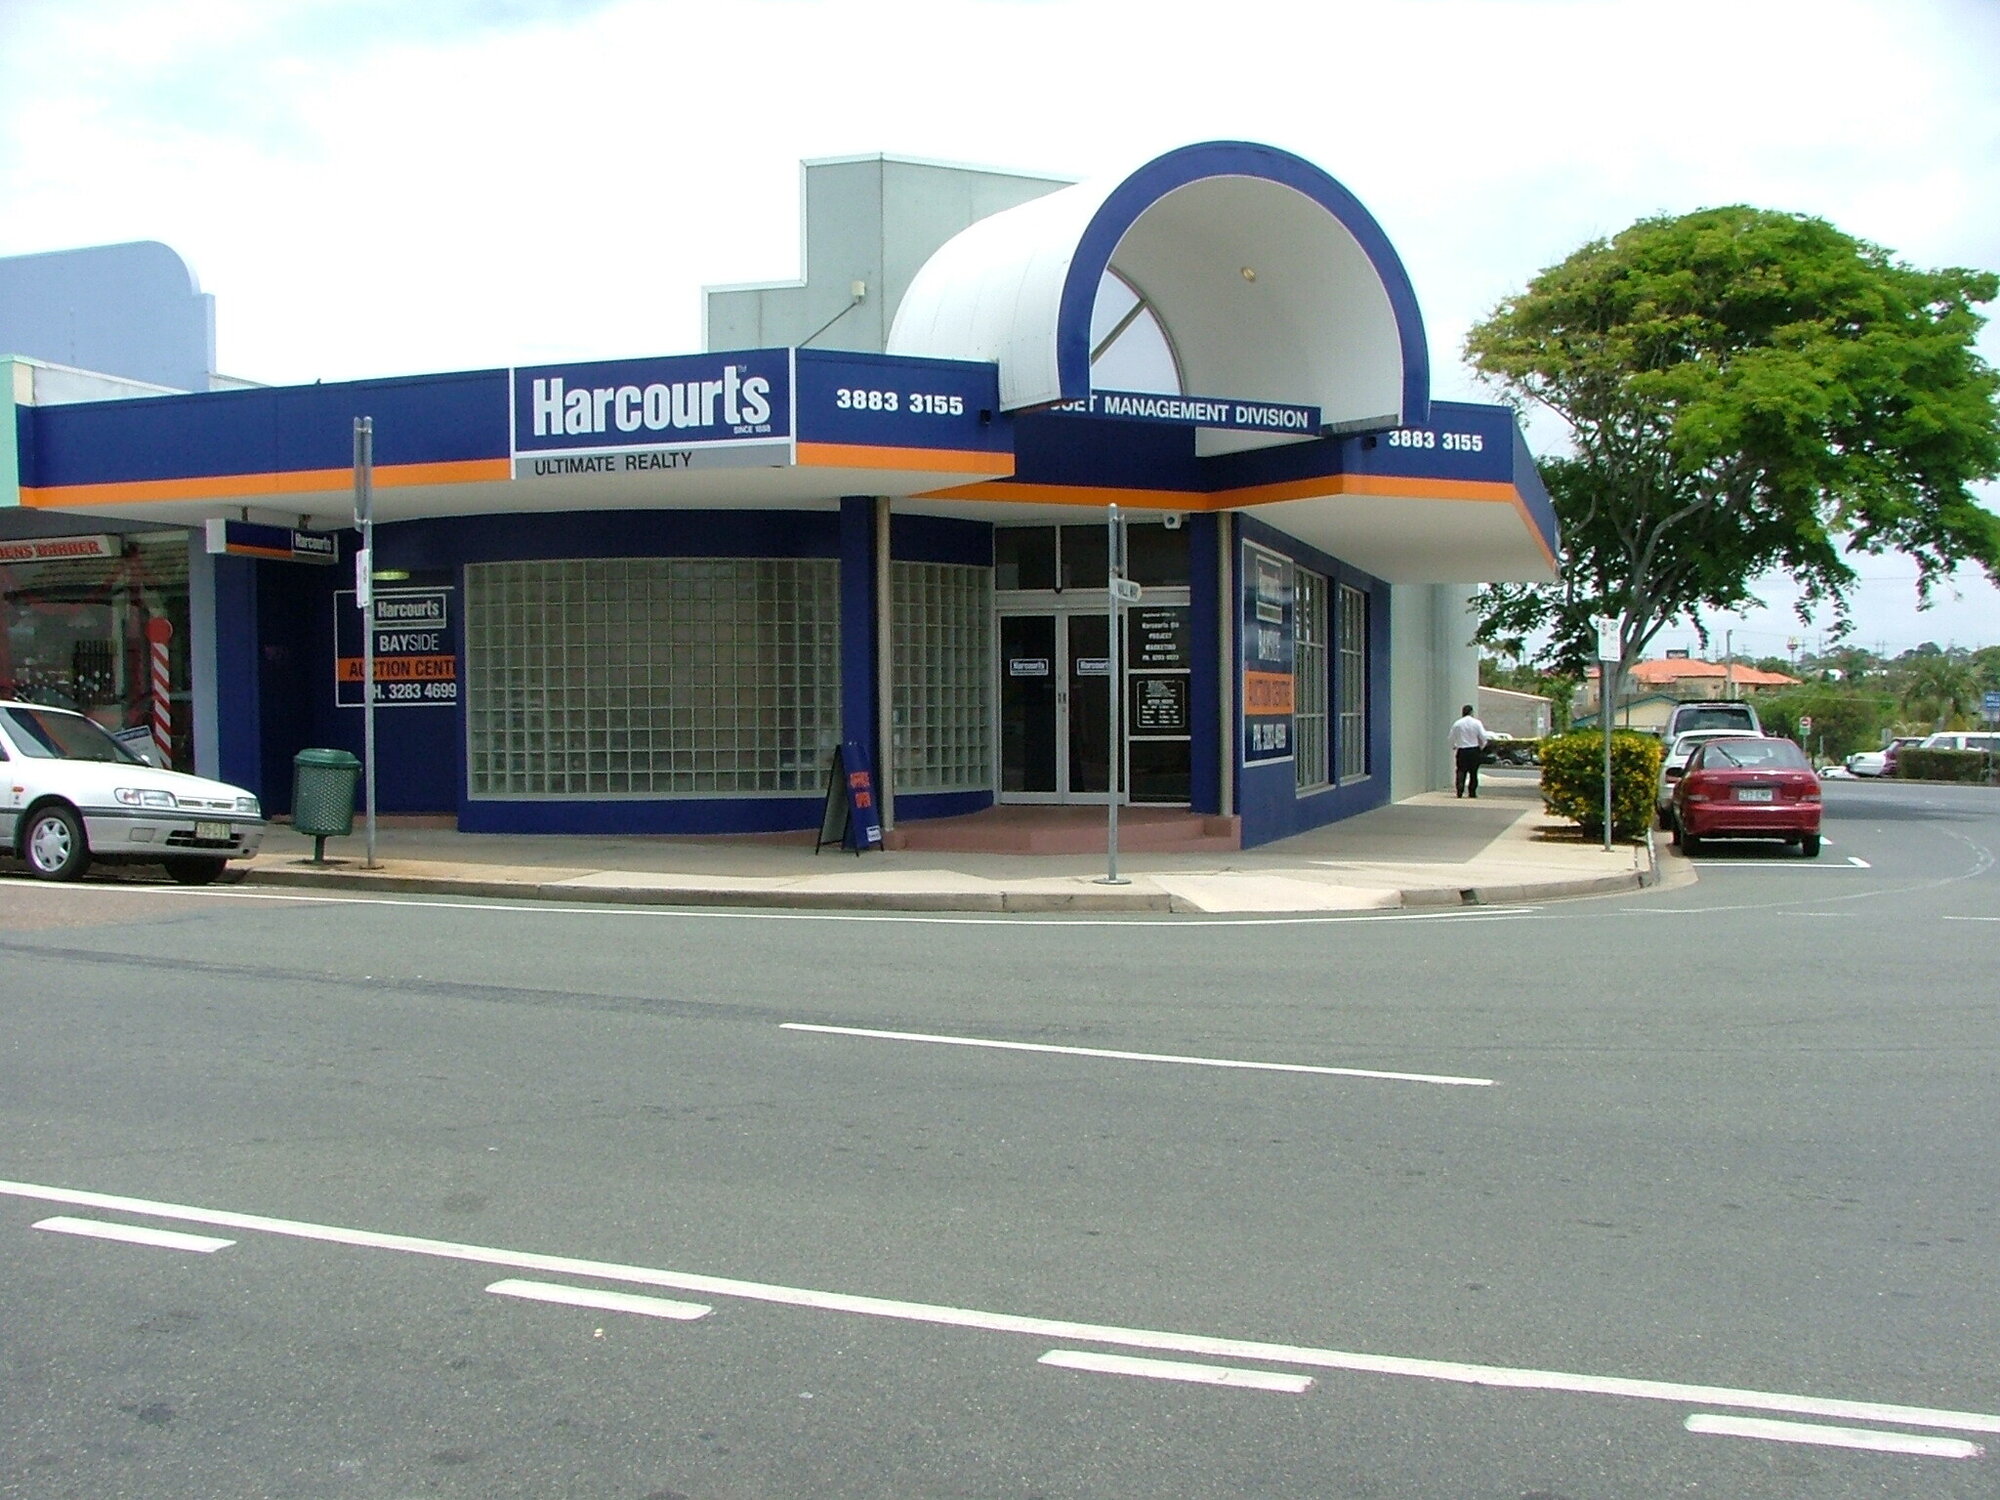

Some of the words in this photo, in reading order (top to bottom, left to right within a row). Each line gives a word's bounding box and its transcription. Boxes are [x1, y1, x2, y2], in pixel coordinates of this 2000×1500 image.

[533, 365, 771, 436] Harcourts
[836, 389, 899, 411] 3883
[909, 393, 964, 415] 3155
[1104, 396, 1230, 422] MANAGEMENT
[1235, 406, 1308, 429] DIVISION
[1388, 429, 1436, 449] 3883
[1442, 433, 1483, 452] 3155
[534, 456, 616, 476] ULTIMATE
[626, 451, 692, 471] REALTY
[378, 600, 440, 617] Harcourts
[379, 633, 440, 652] BAYSIDE
[389, 684, 421, 699] 3283
[424, 683, 456, 699] 4699
